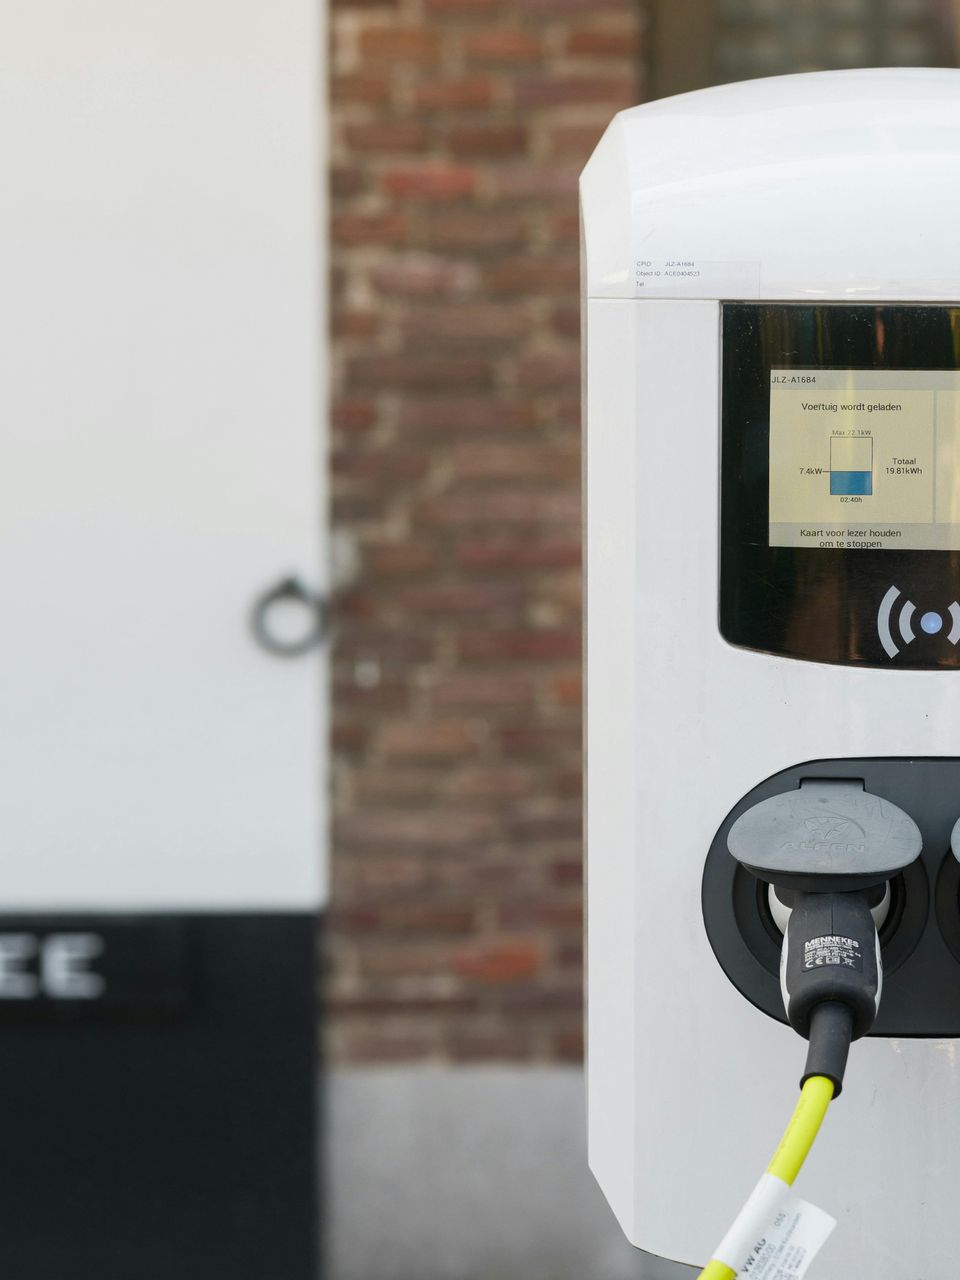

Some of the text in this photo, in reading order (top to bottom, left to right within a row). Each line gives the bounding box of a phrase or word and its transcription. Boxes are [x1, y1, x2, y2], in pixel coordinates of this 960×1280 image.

[771, 376, 817, 384] JLZ-A1684
[801, 402, 902, 413] Voertuig wordt geladen
[892, 457, 917, 465] Totaal
[799, 467, 823, 475] 7.4kW
[885, 467, 923, 475] 19.81kWh
[800, 529, 902, 538] Kaart voor lezer houden
[819, 540, 883, 550] om te stoppen
[779, 840, 866, 855] ALFEN
[805, 936, 860, 951] MENNEKES
[740, 1255, 756, 1274] VW
